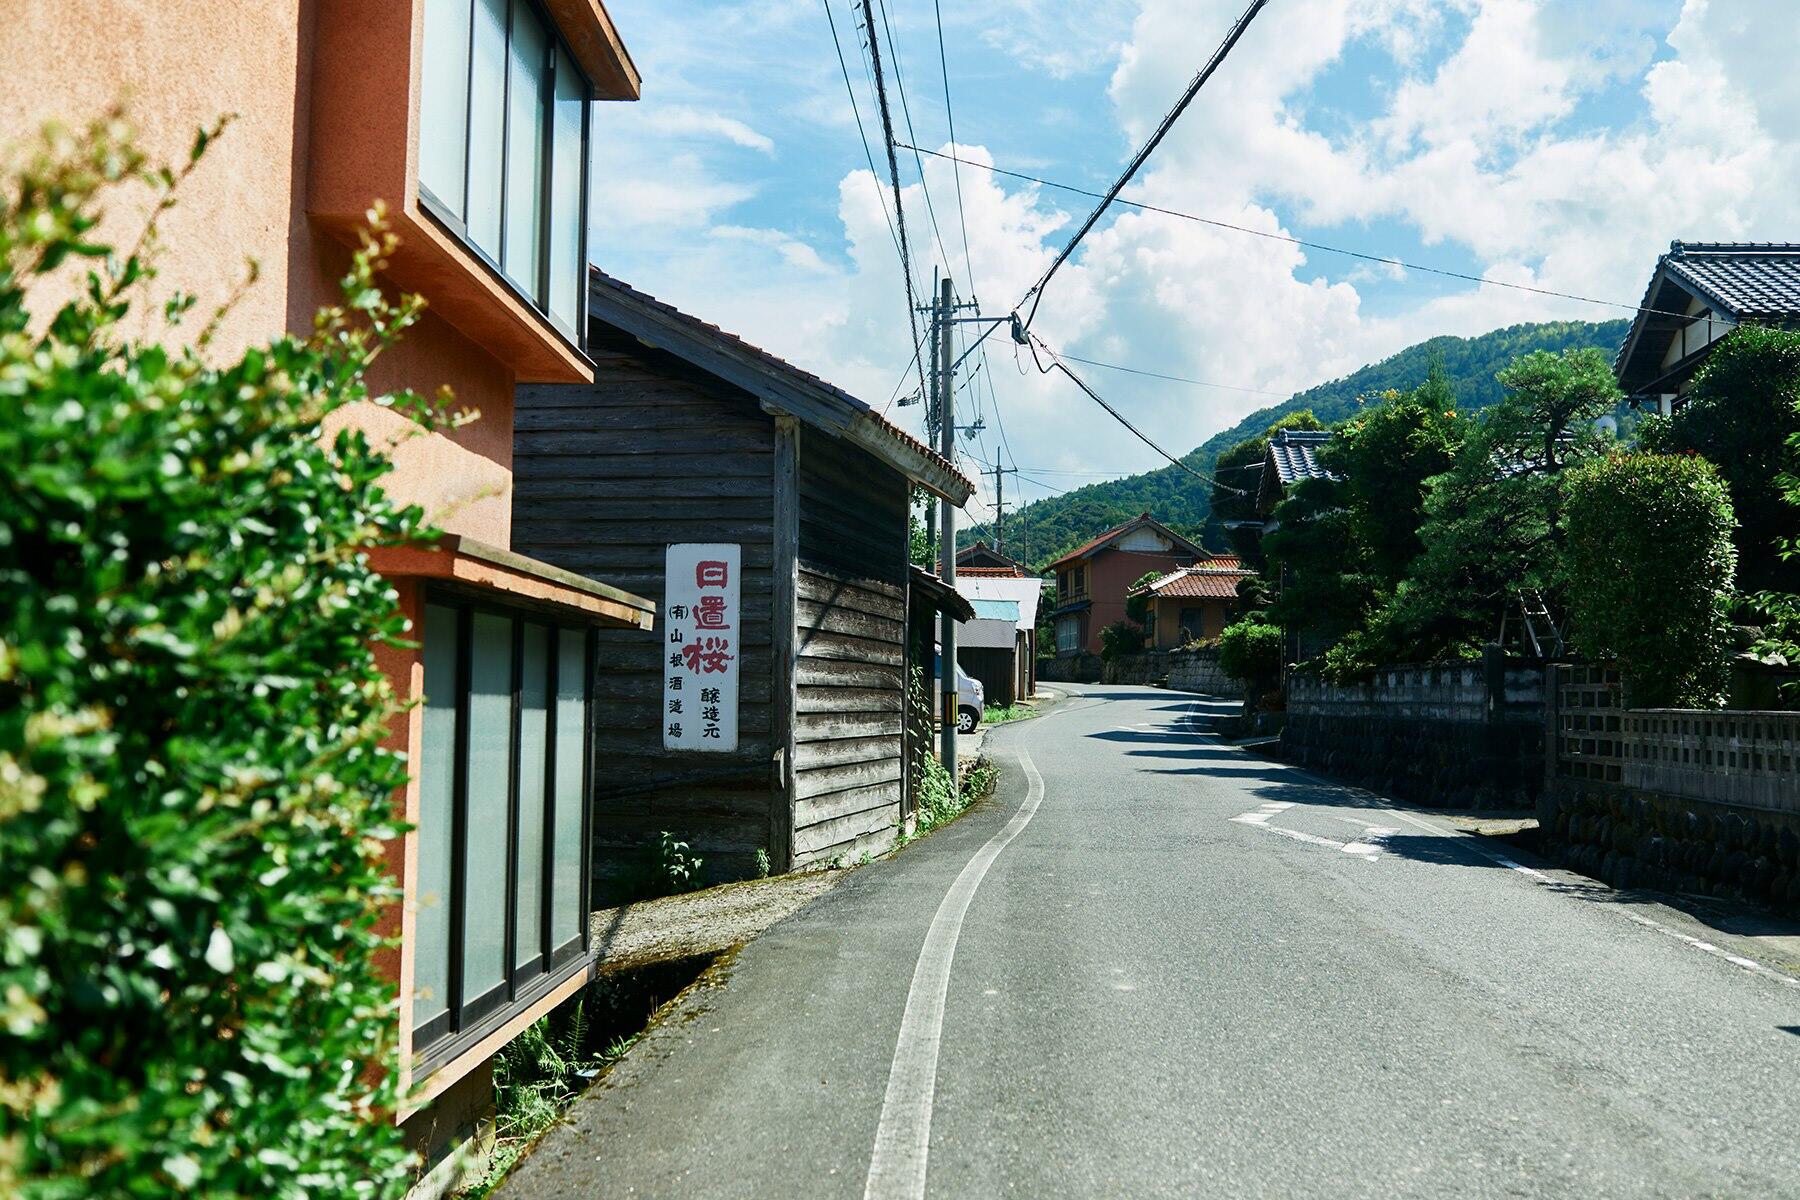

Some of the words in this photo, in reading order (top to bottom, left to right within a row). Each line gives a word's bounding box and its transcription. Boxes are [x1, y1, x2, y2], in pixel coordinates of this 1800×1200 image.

[681, 560, 735, 675] 日置桜
[701, 687, 721, 739] 醸造元
